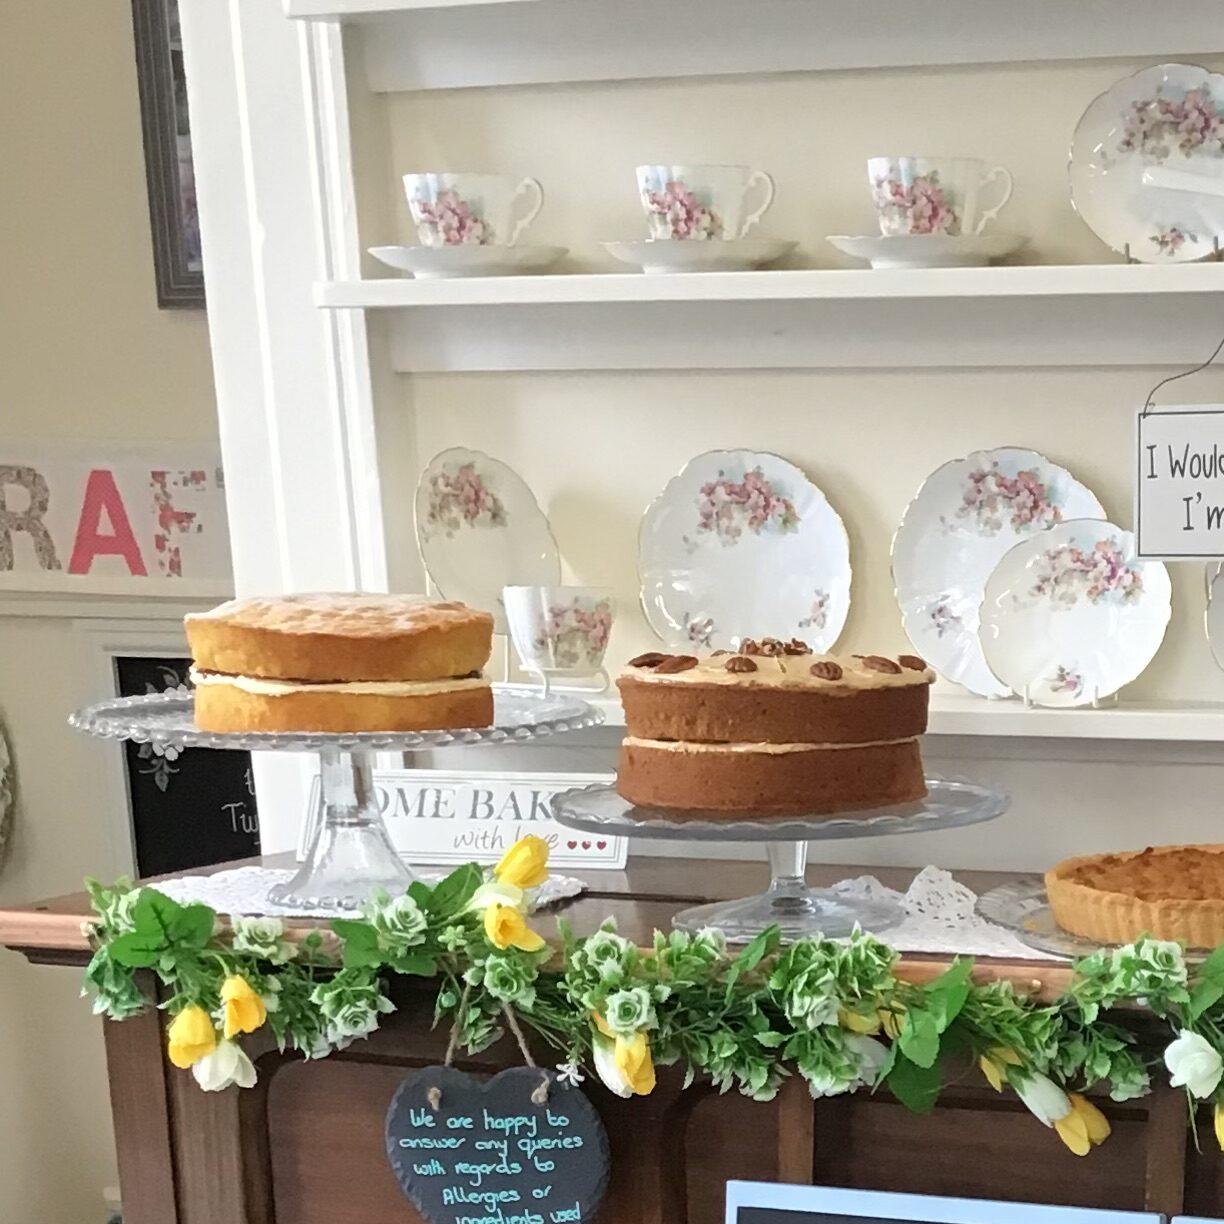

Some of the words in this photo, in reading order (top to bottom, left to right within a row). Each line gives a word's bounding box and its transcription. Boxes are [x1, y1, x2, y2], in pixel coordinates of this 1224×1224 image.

[1146, 444, 1158, 479] I
[0, 464, 224, 577] RAF
[374, 786, 456, 819] OME
[468, 789, 556, 821] BAK
[454, 825, 505, 850] with
[409, 1107, 436, 1128] We
[446, 1114, 474, 1129] are
[483, 1109, 537, 1137] happy
[546, 1109, 570, 1127] to
[399, 1137, 466, 1149] answer
[475, 1139, 508, 1157] any
[517, 1131, 584, 1159] queries
[454, 1157, 522, 1186] regards
[534, 1156, 555, 1172] to
[442, 1186, 520, 1212] Allergies
[532, 1186, 552, 1199] or
[550, 1201, 581, 1223] used
